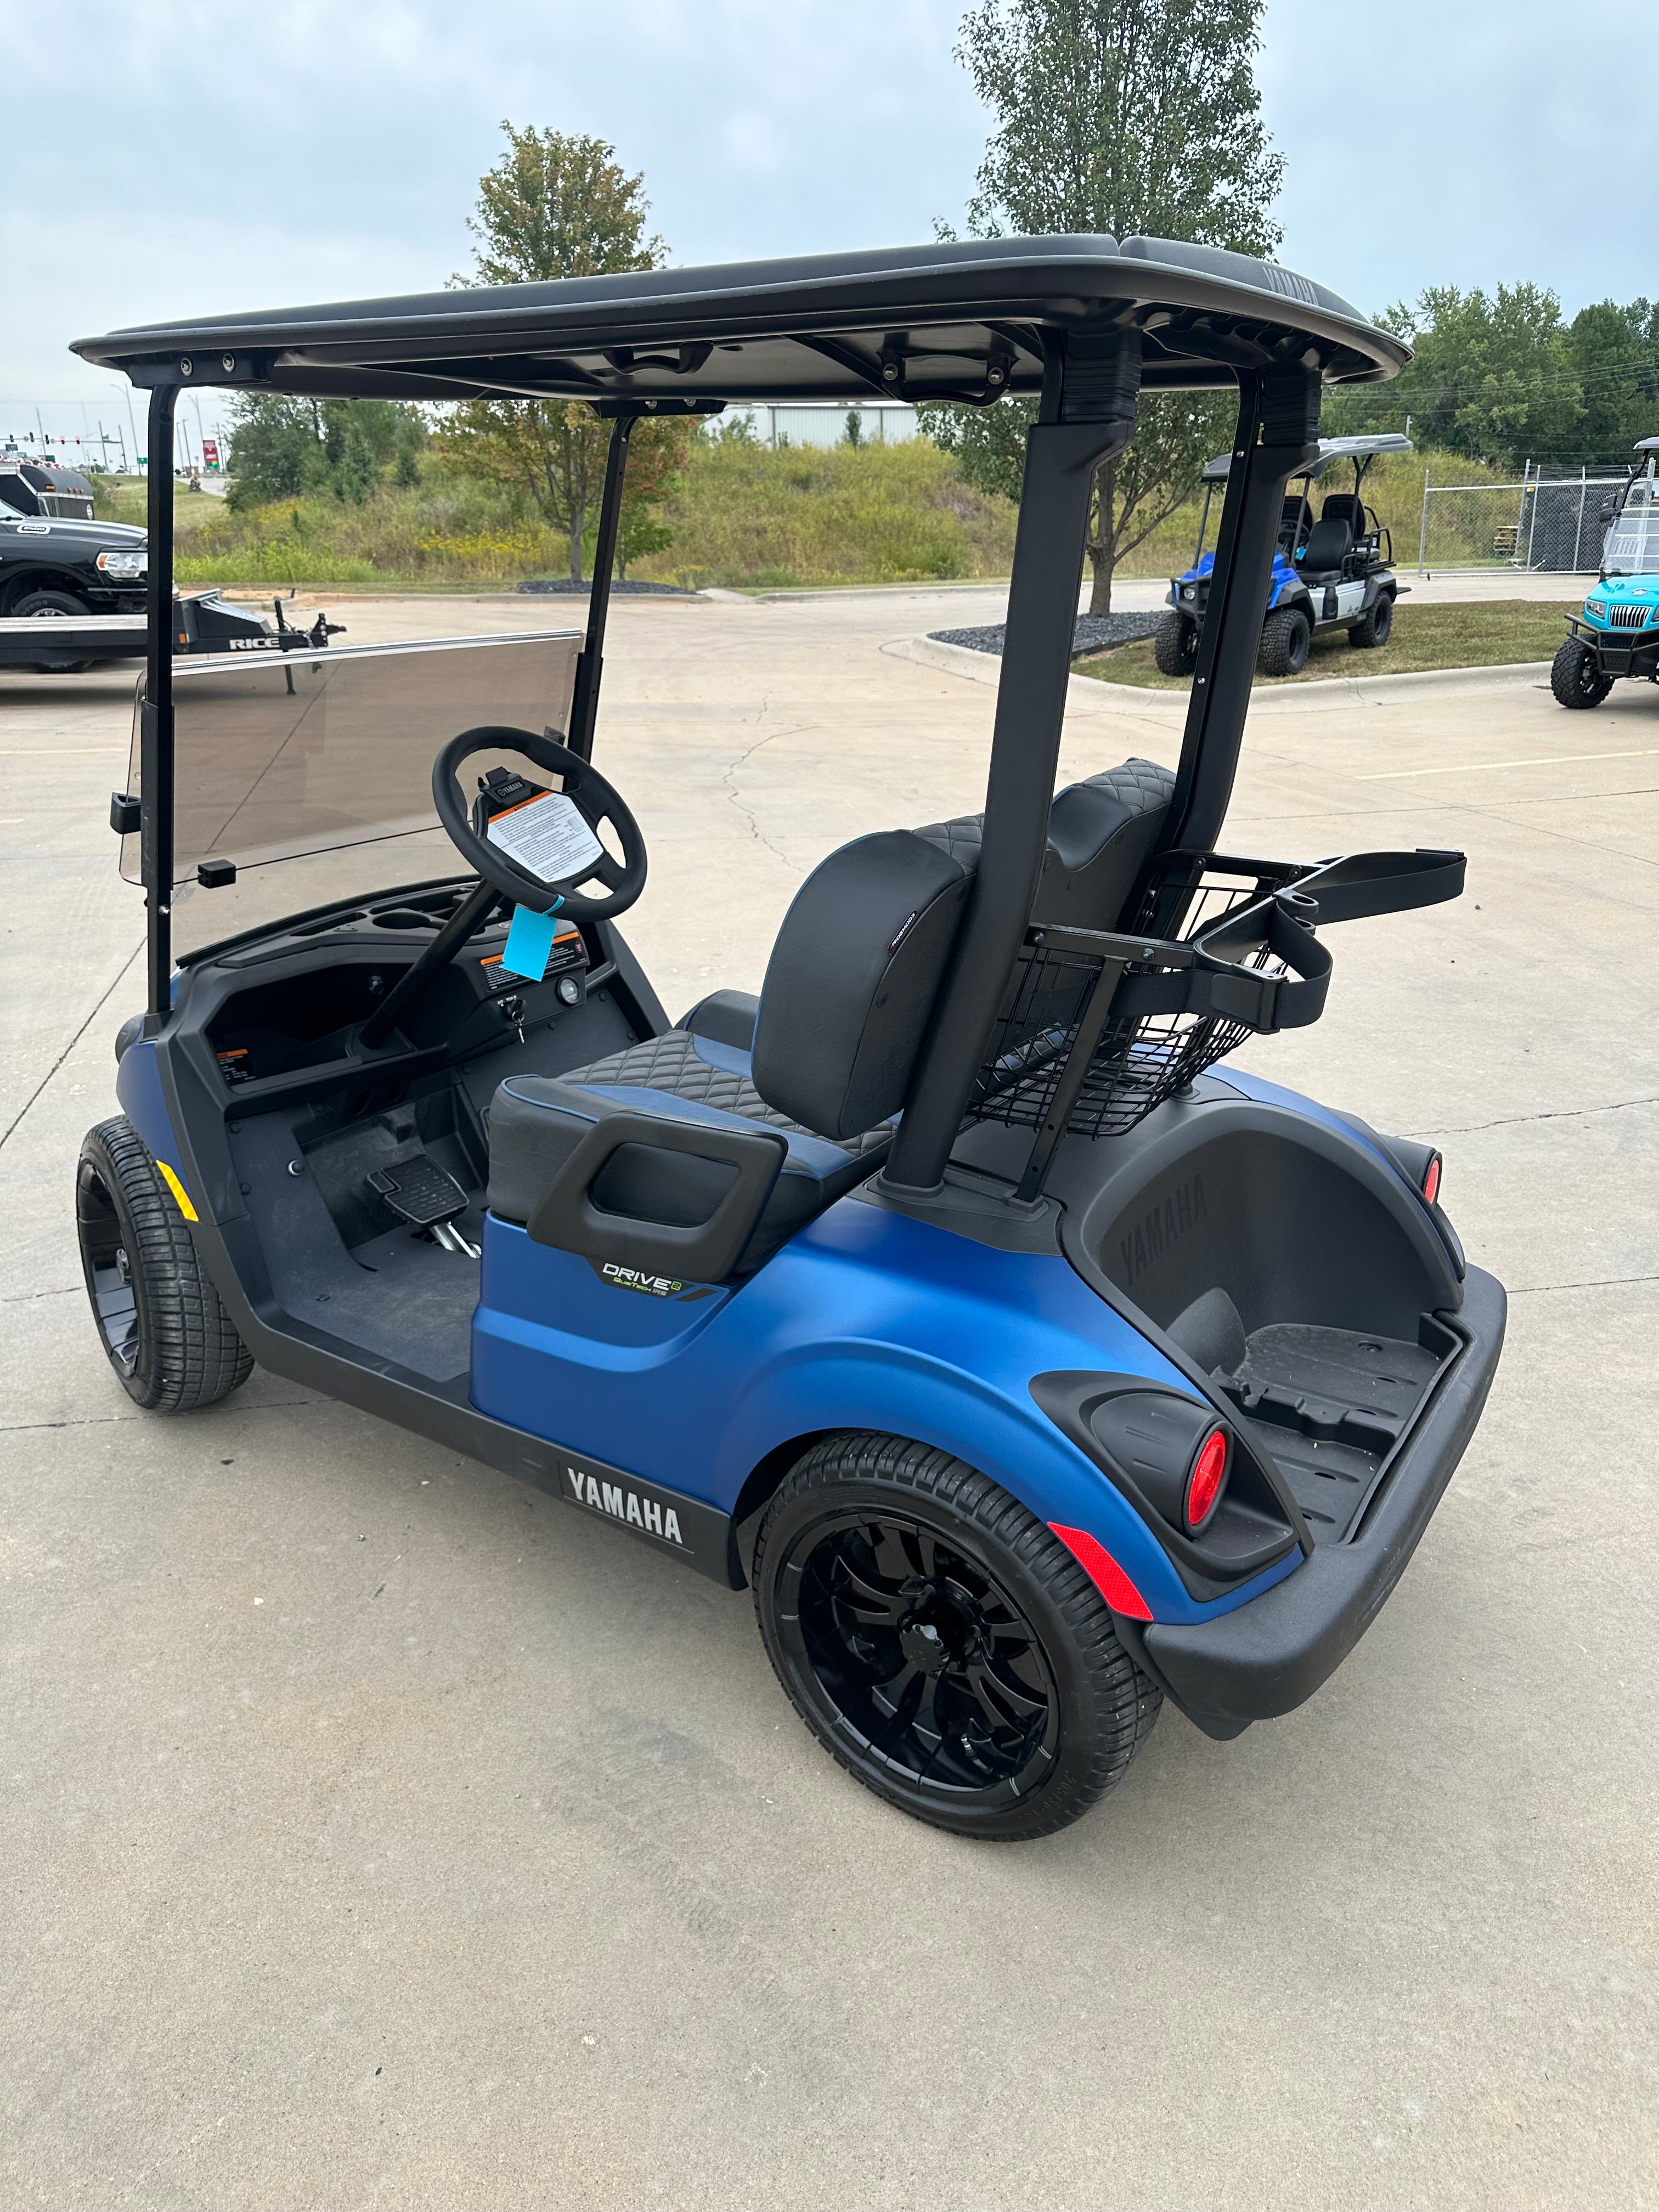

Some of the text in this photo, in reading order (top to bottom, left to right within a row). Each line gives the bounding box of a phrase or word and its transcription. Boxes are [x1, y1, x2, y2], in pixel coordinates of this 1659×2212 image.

[1262, 266, 1319, 307] YAMAHA
[229, 637, 280, 650] RICE
[502, 781, 523, 794] YAMAHA
[1120, 1173, 1207, 1286] YAMAHA
[652, 1288, 667, 1296] IRS
[567, 1467, 683, 1544] YAMAHA
